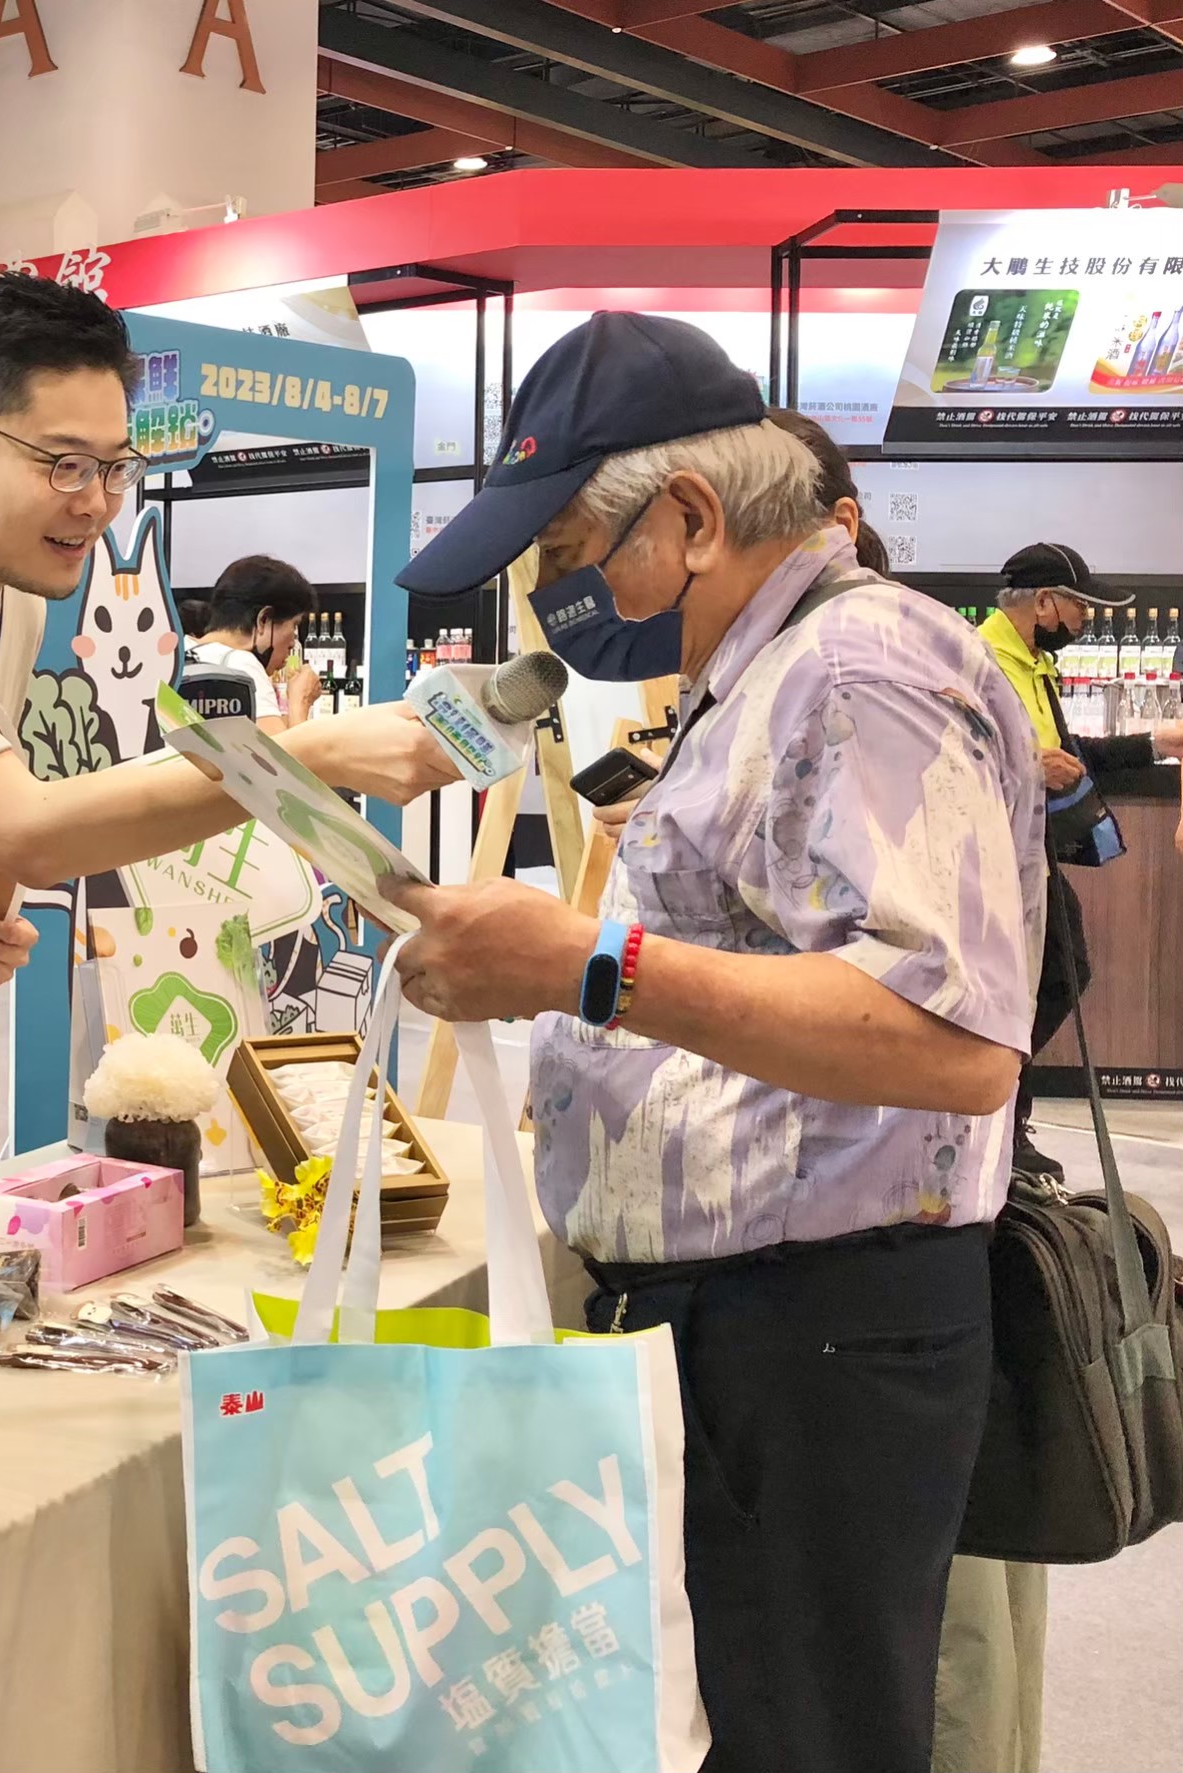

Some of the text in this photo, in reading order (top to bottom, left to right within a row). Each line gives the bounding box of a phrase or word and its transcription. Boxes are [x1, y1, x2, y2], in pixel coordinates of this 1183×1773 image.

[200, 363, 389, 419] 2023/8/4-8/7
[1129, 411, 1183, 421] 找代駕保平
[220, 1391, 264, 1416] 泰山
[198, 1430, 443, 1634] SALT
[249, 1453, 643, 1746] SUPPLY
